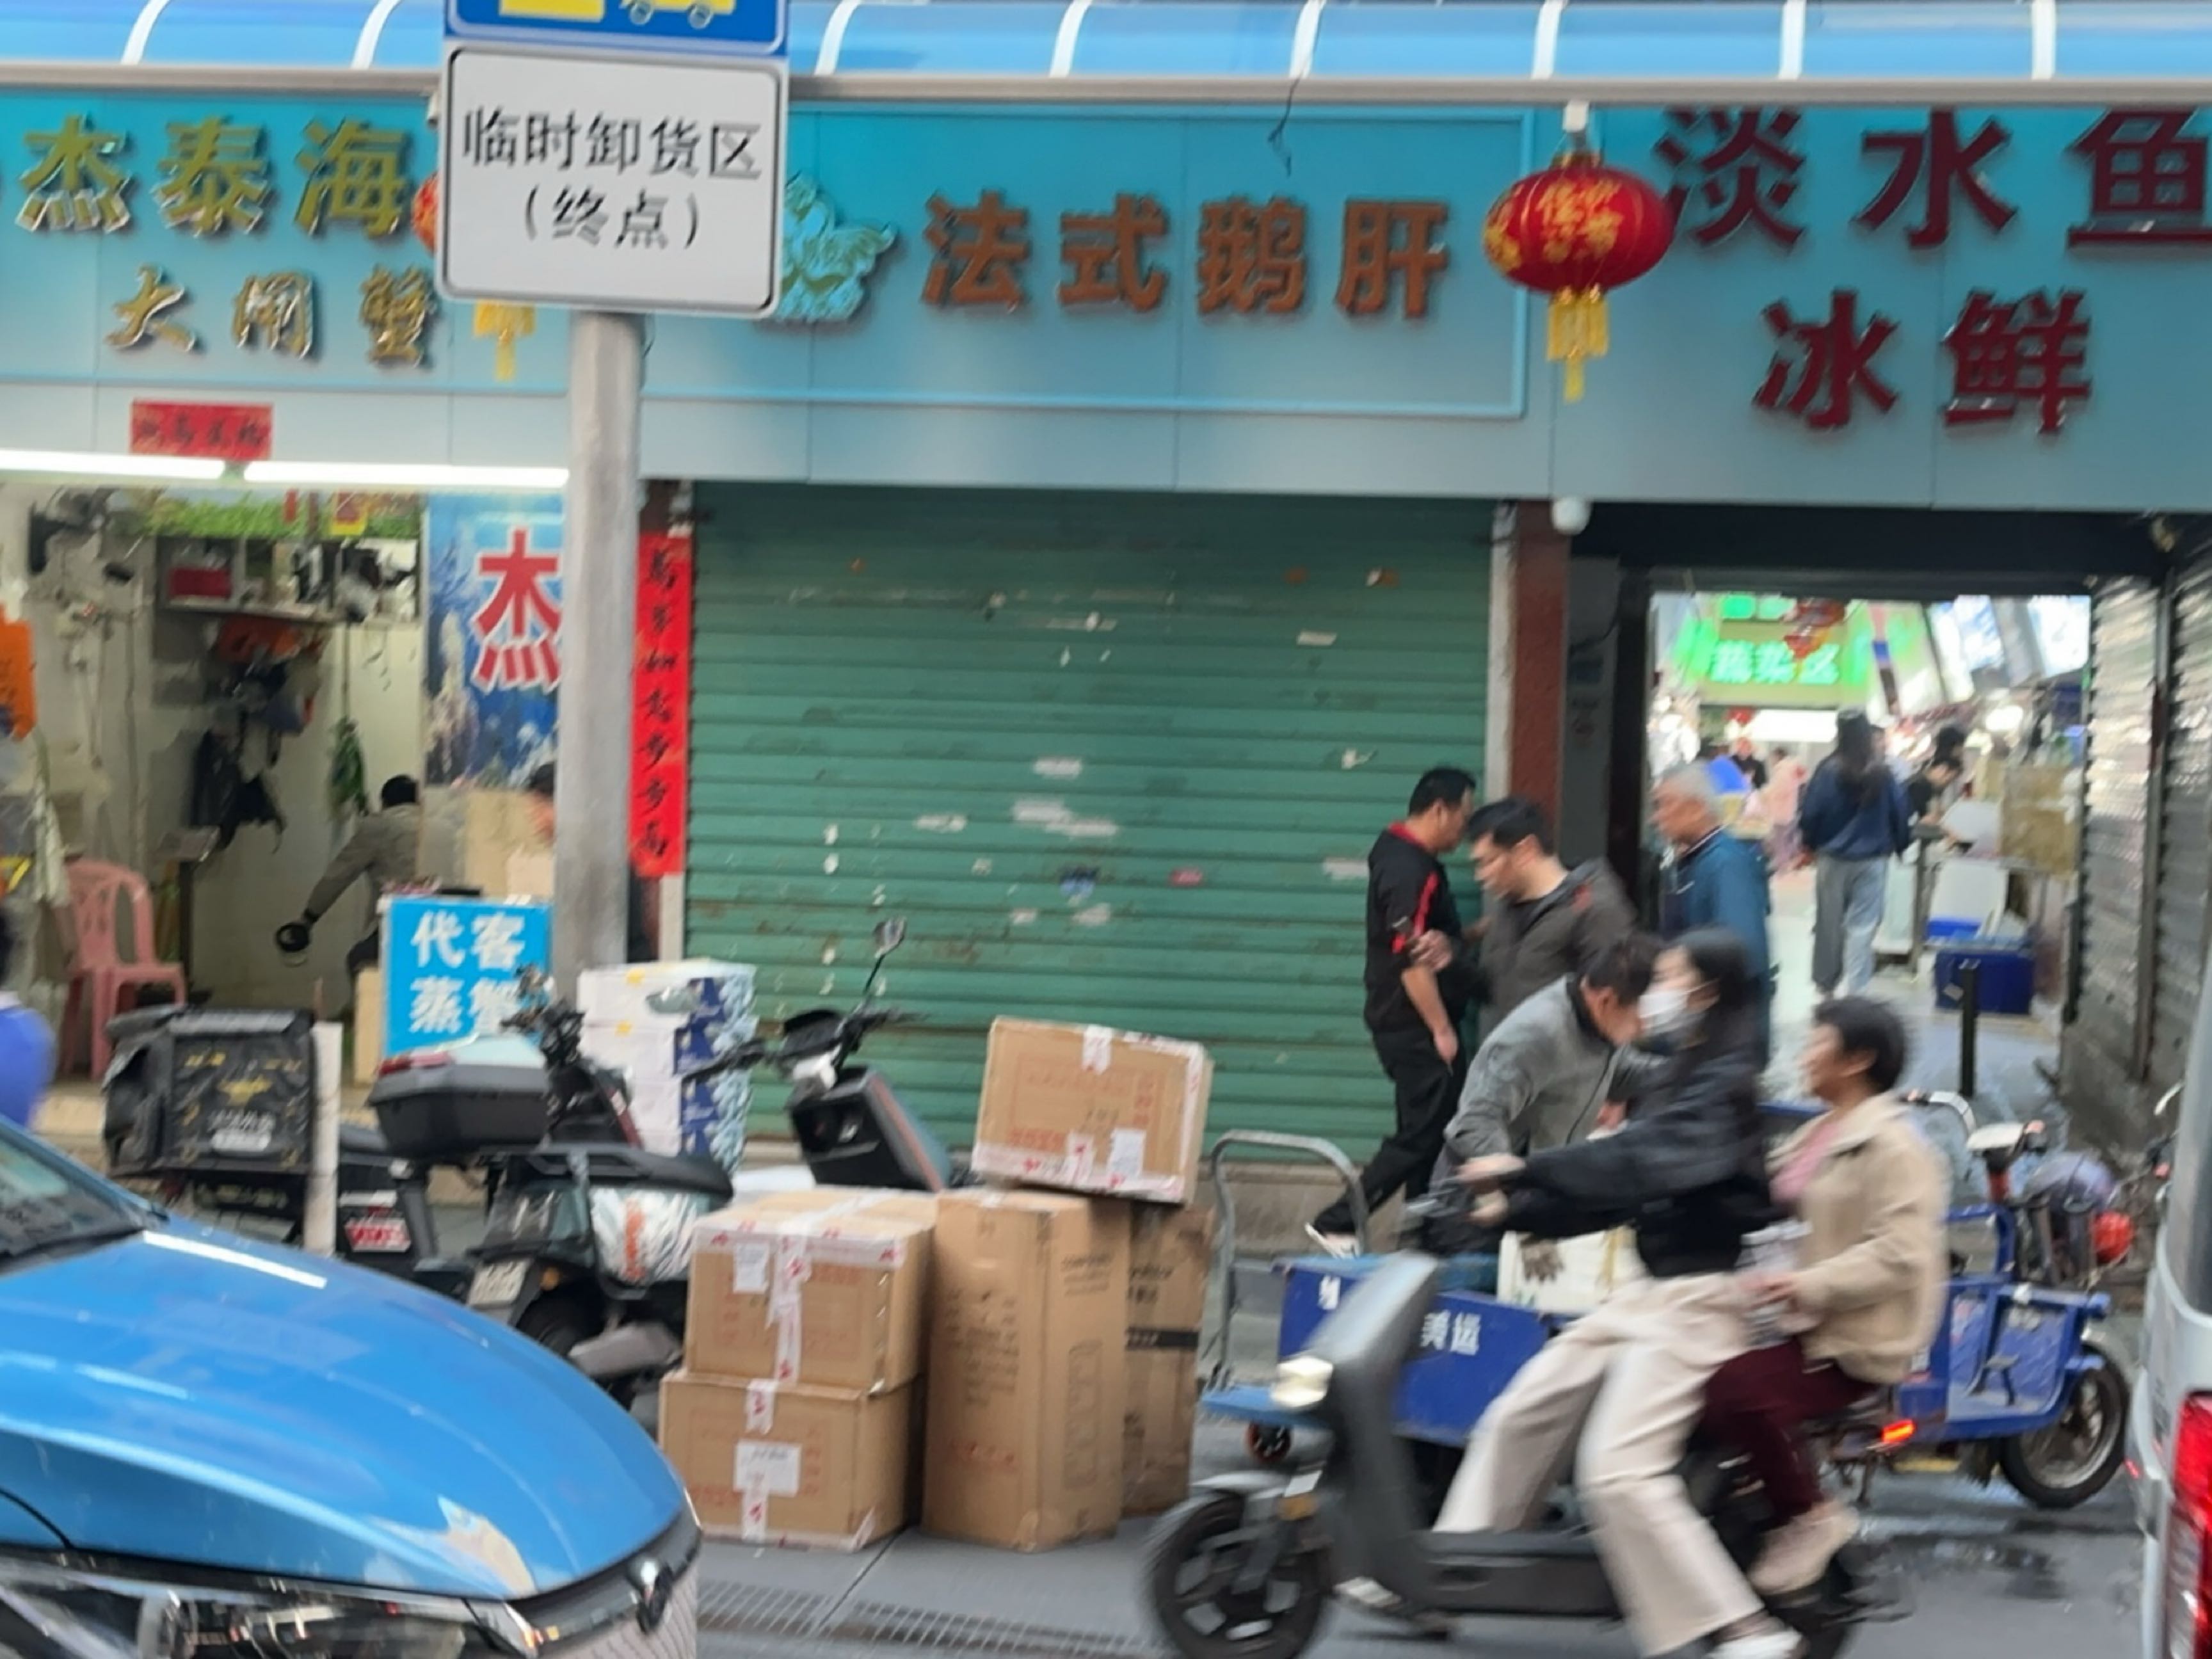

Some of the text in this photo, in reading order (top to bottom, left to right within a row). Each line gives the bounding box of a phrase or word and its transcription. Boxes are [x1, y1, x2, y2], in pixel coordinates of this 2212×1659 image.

[17, 115, 411, 237] 杰泰海
[462, 106, 762, 180] 临时卸货区
[1653, 104, 2212, 248] 淡水鱼
[920, 188, 1449, 317] 法式鹅肝
[105, 264, 435, 367] 大闸蟹
[1752, 288, 2093, 437] 冰鲜
[471, 527, 563, 693] 杰
[410, 909, 525, 971] 代客
